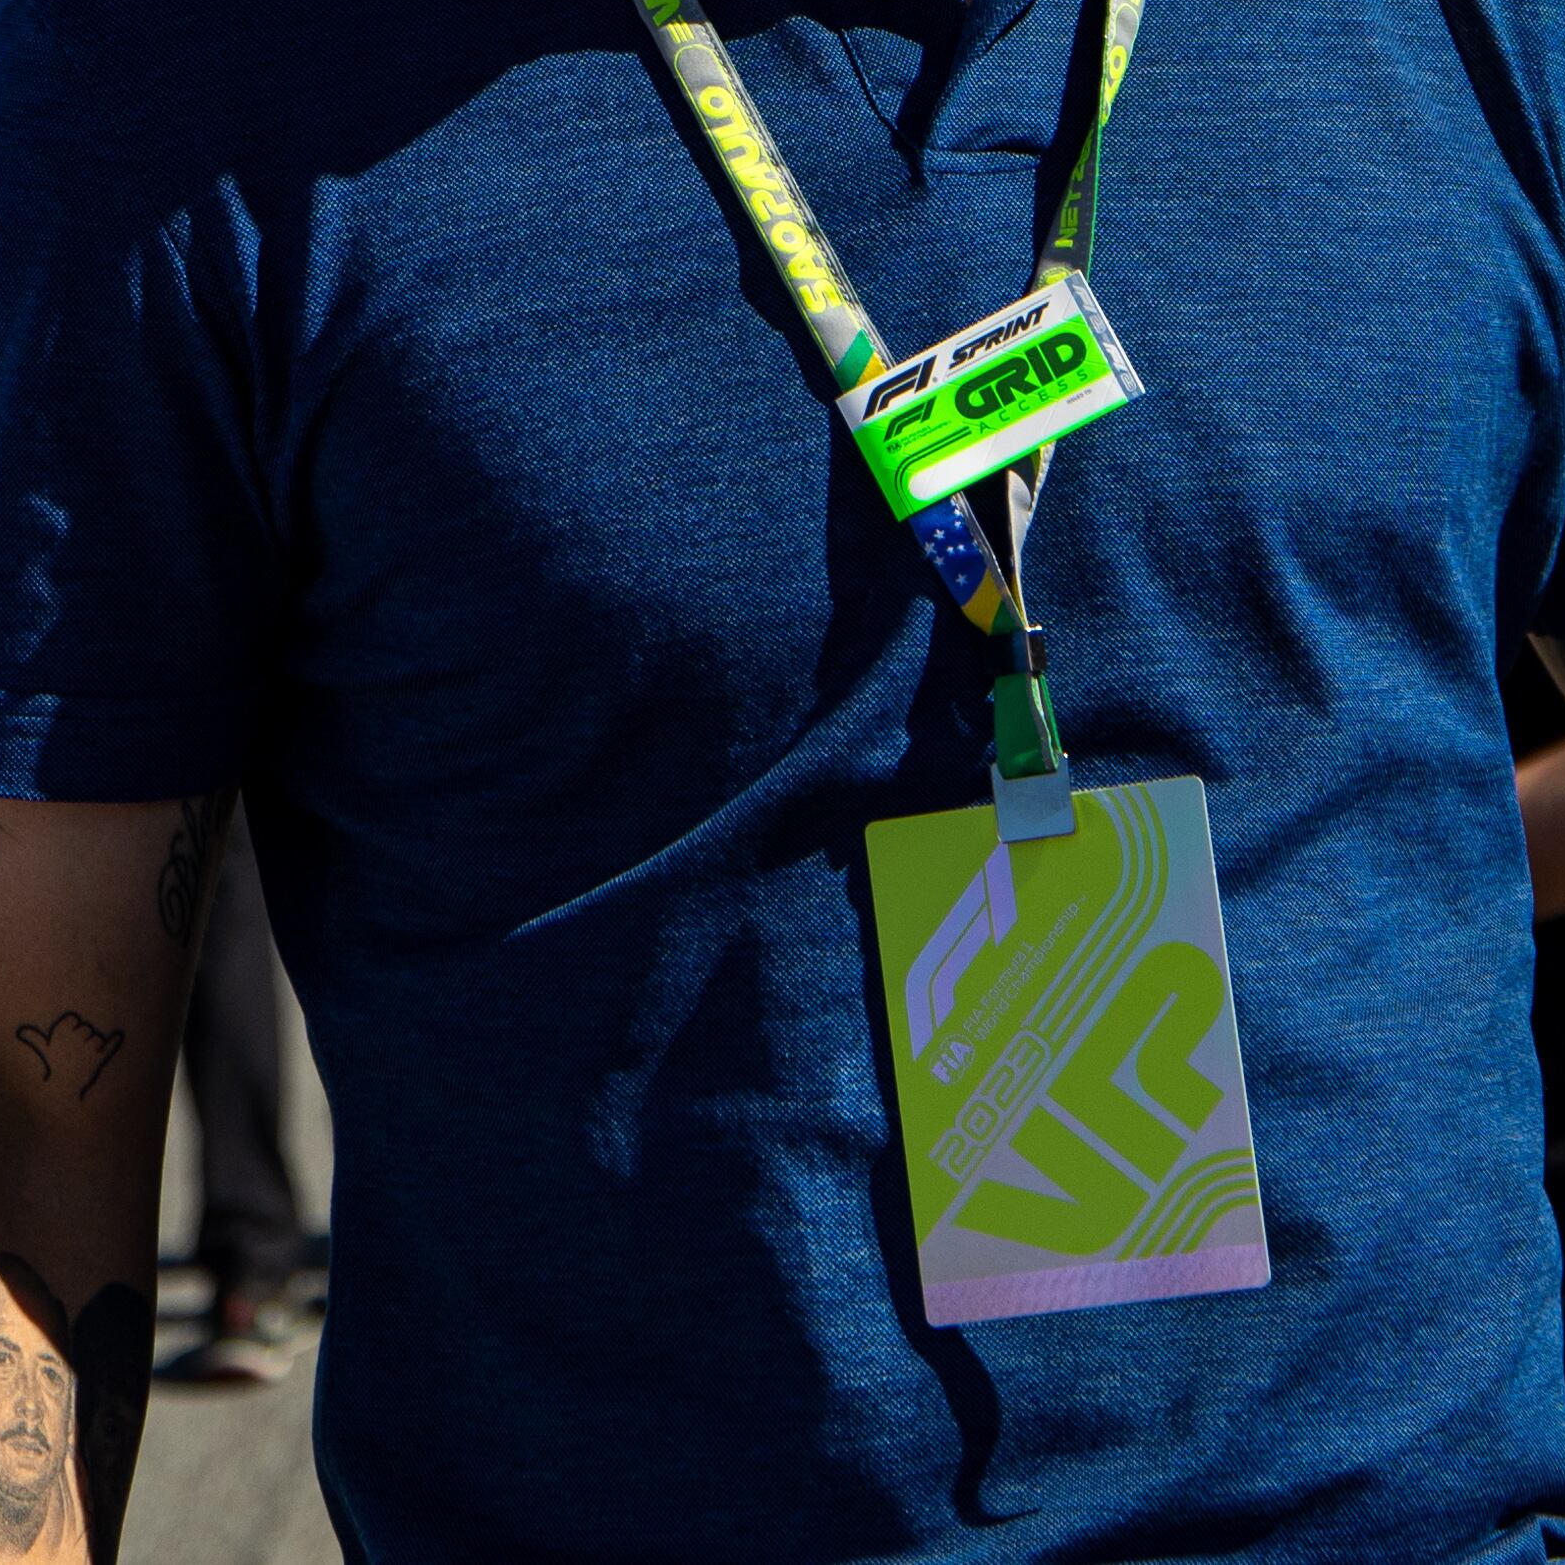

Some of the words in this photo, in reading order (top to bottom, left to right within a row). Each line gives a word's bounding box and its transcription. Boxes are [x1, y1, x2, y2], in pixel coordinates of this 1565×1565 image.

[698, 85, 793, 222] PAULO
[1054, 189, 1082, 248] NET
[862, 355, 937, 421] F1
[948, 302, 1050, 370] SPRINT
[954, 332, 1087, 420] GRID
[979, 371, 1088, 434] ACCESS
[884, 395, 937, 442] F1
[907, 842, 1018, 1062] F1
[931, 1041, 974, 1084] FIA
[975, 999, 1010, 1040] World
[928, 1029, 1053, 1183] 2023
[950, 941, 1227, 1256] VIP
